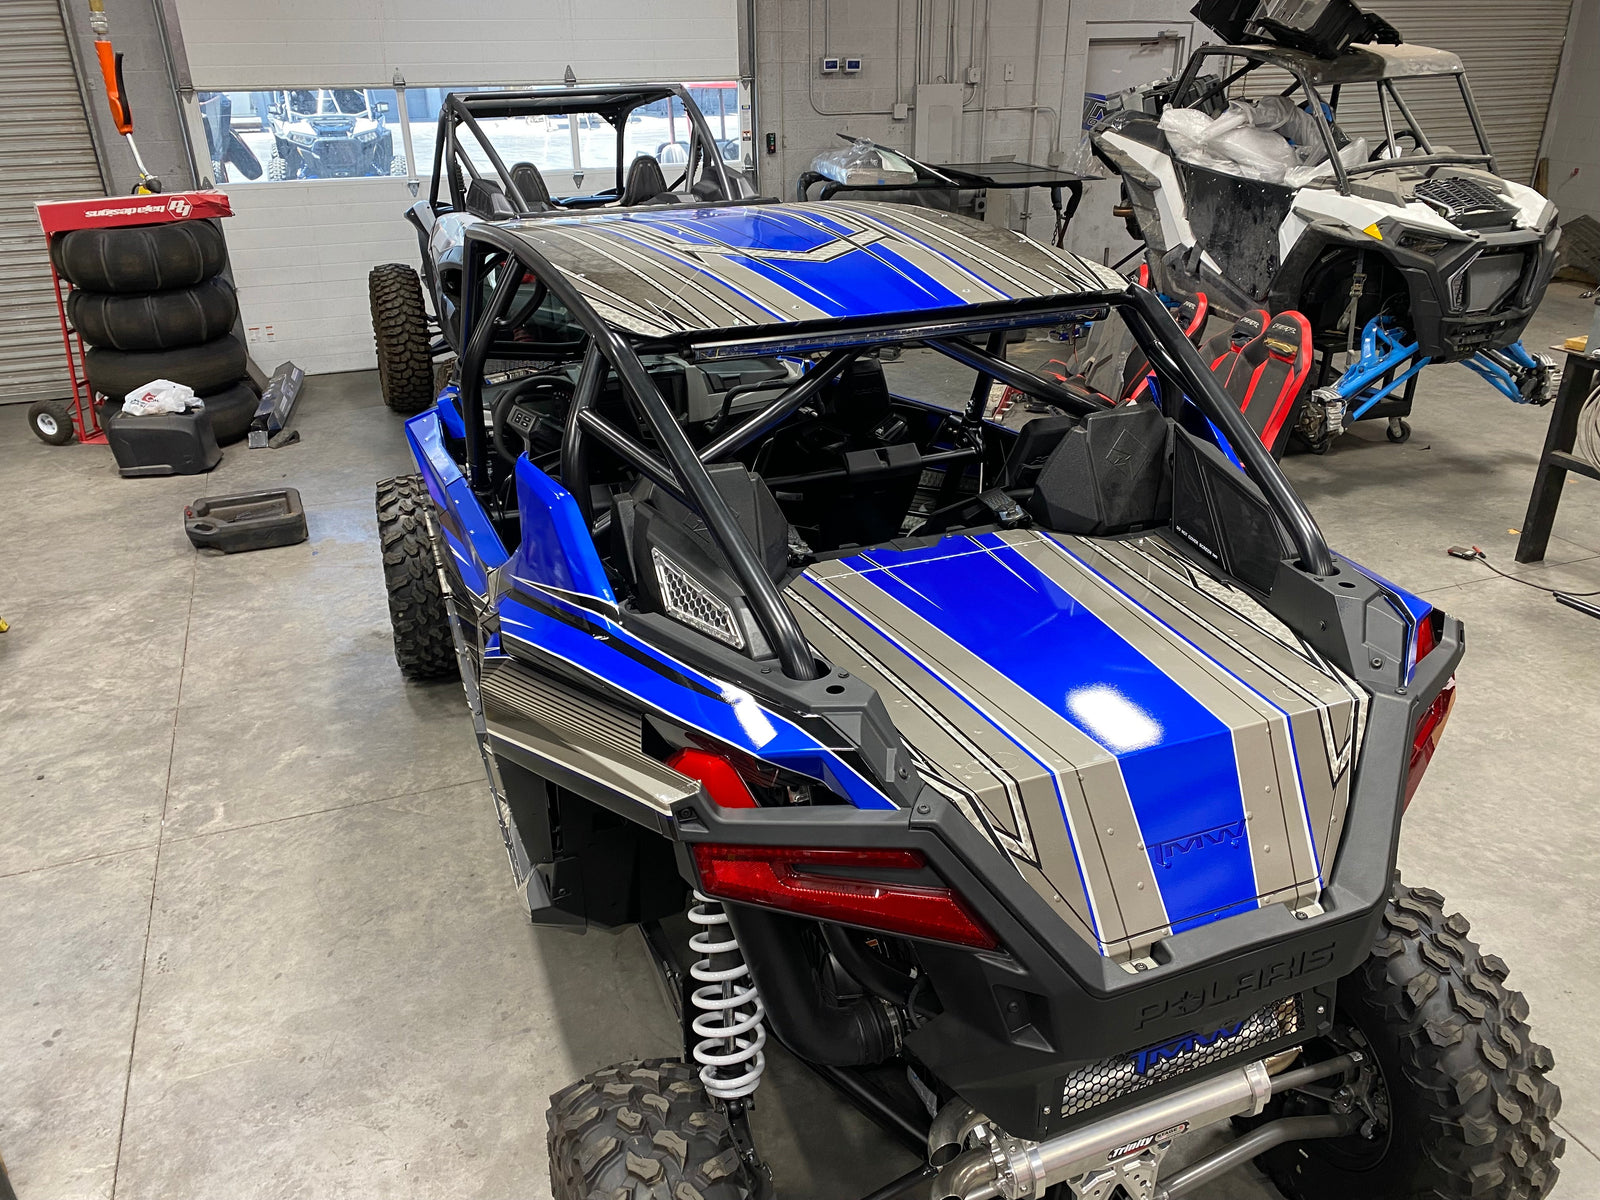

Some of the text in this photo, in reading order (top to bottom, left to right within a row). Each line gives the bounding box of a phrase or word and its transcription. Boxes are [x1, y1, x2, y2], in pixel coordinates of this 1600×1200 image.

[84, 206, 137, 218] designs
[137, 204, 166, 214] baja
[1199, 542, 1212, 555] SCREEN
[1145, 819, 1247, 867] TMW
[1133, 941, 1336, 1032] POLARIS
[1130, 1020, 1244, 1075] TMW
[1112, 1135, 1154, 1158] Trinity
